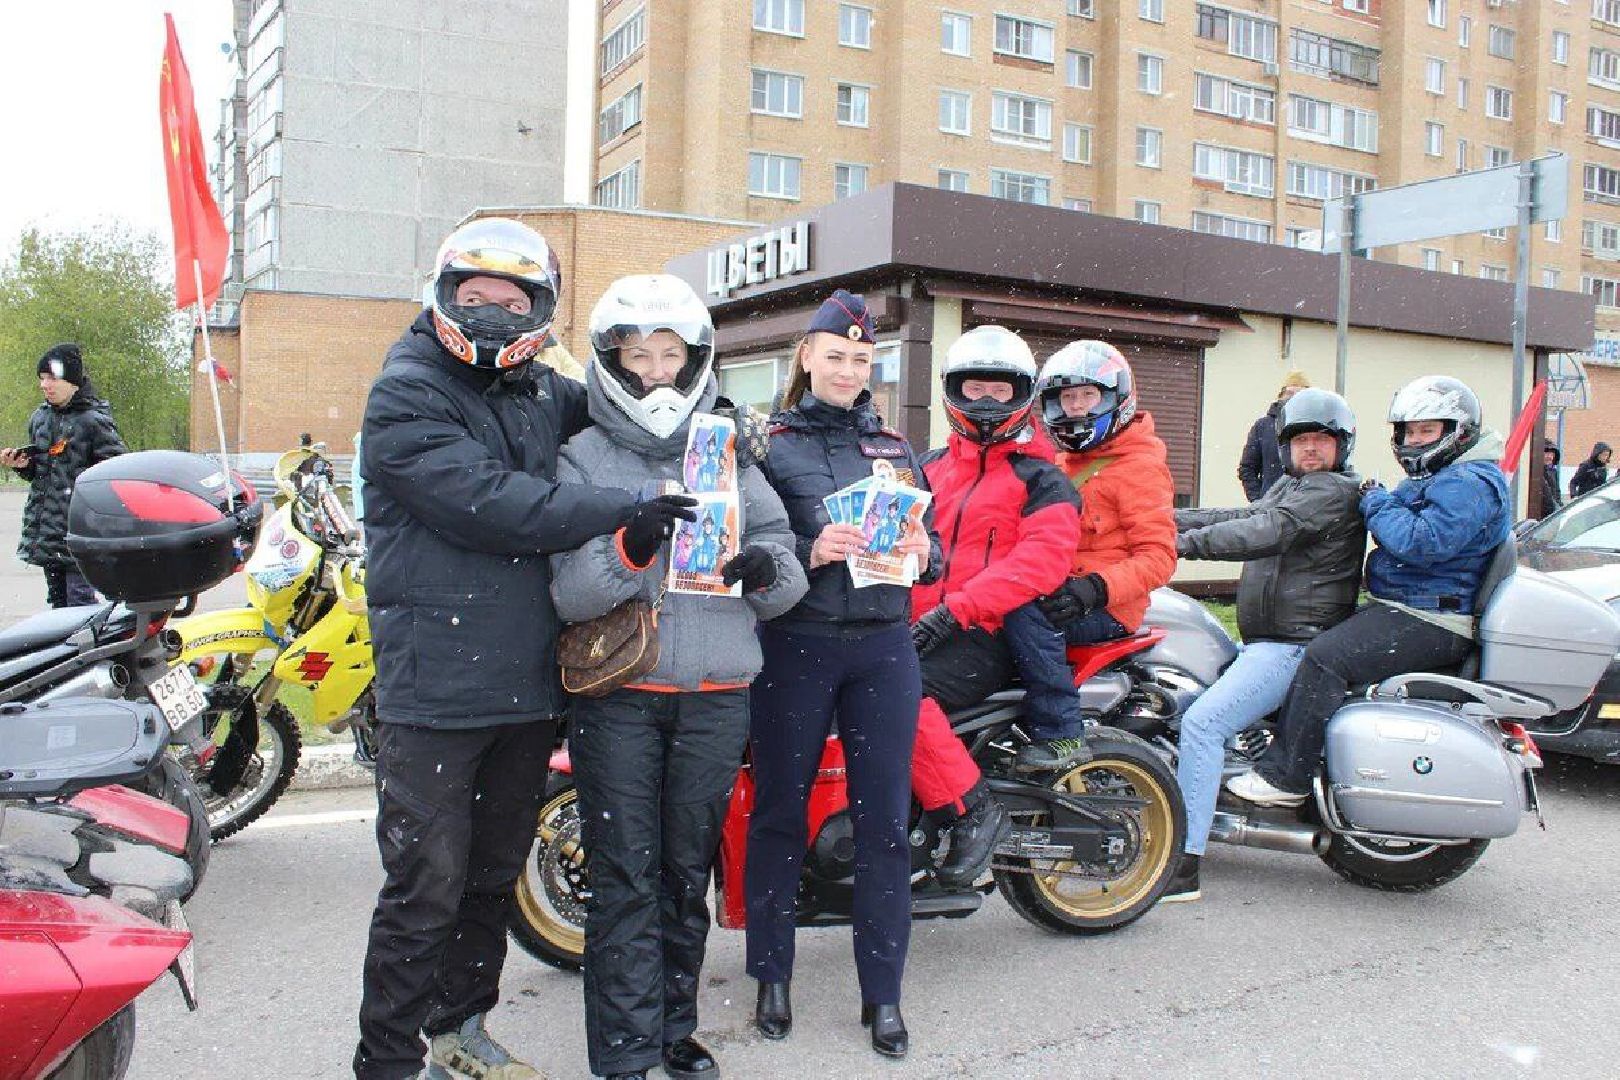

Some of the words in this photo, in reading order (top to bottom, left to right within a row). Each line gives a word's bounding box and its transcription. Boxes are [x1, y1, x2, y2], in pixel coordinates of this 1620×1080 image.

[707, 221, 810, 298] ЦВЕТЫ
[155, 667, 190, 700] 2671
[185, 690, 204, 711] 50
